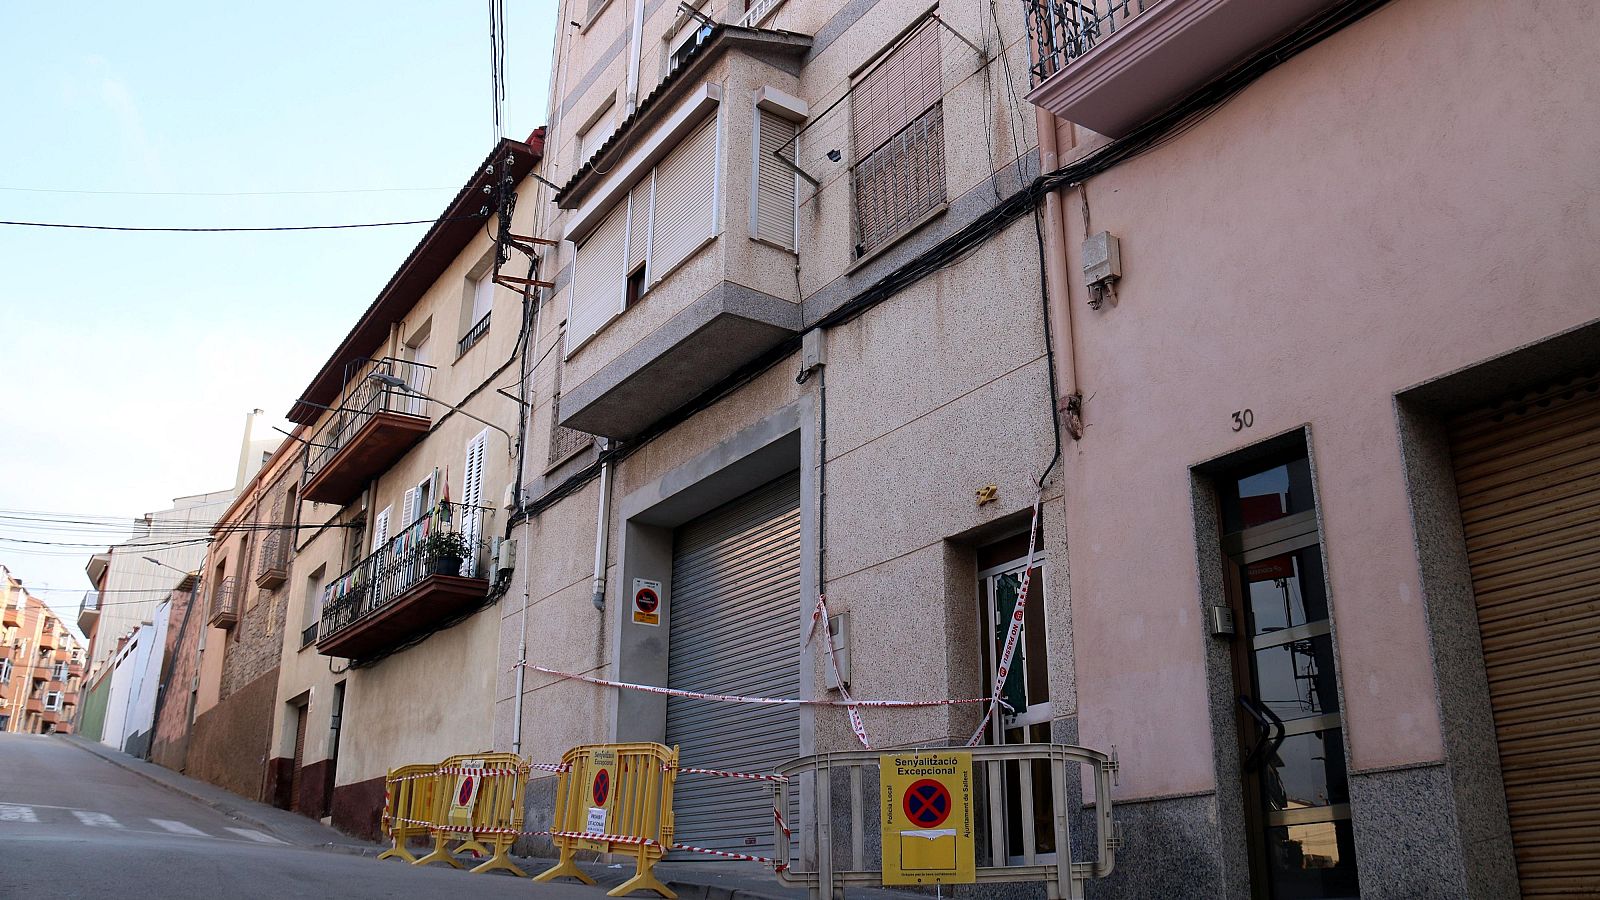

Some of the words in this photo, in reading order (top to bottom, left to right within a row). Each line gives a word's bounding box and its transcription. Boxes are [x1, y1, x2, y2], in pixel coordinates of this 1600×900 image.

[1231, 408, 1254, 432] 30
[1011, 623, 1019, 637] NO
[895, 757, 958, 767] Senyalització
[897, 767, 956, 776] Excepcional
[963, 793, 969, 801] de
